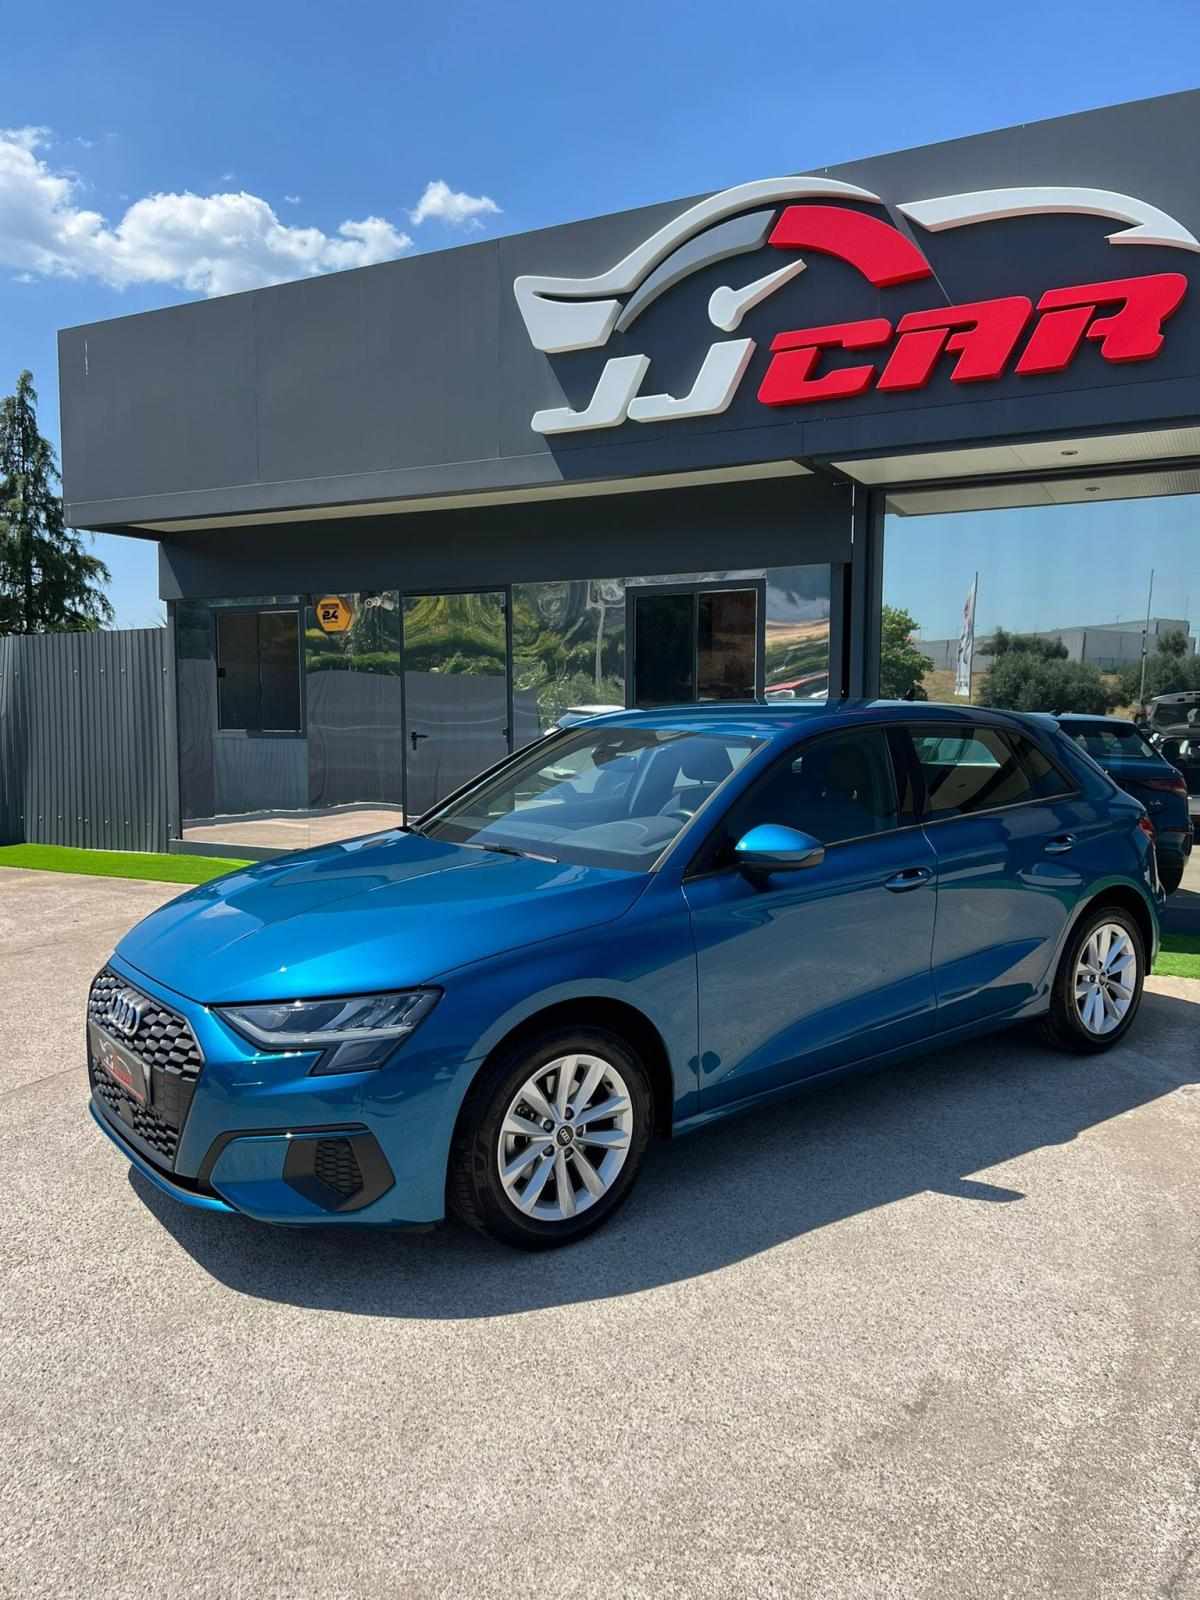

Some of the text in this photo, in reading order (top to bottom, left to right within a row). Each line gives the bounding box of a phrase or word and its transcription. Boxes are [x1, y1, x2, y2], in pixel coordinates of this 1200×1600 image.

[531, 273, 1187, 433] JJ CAR
[323, 610, 339, 620] 24
